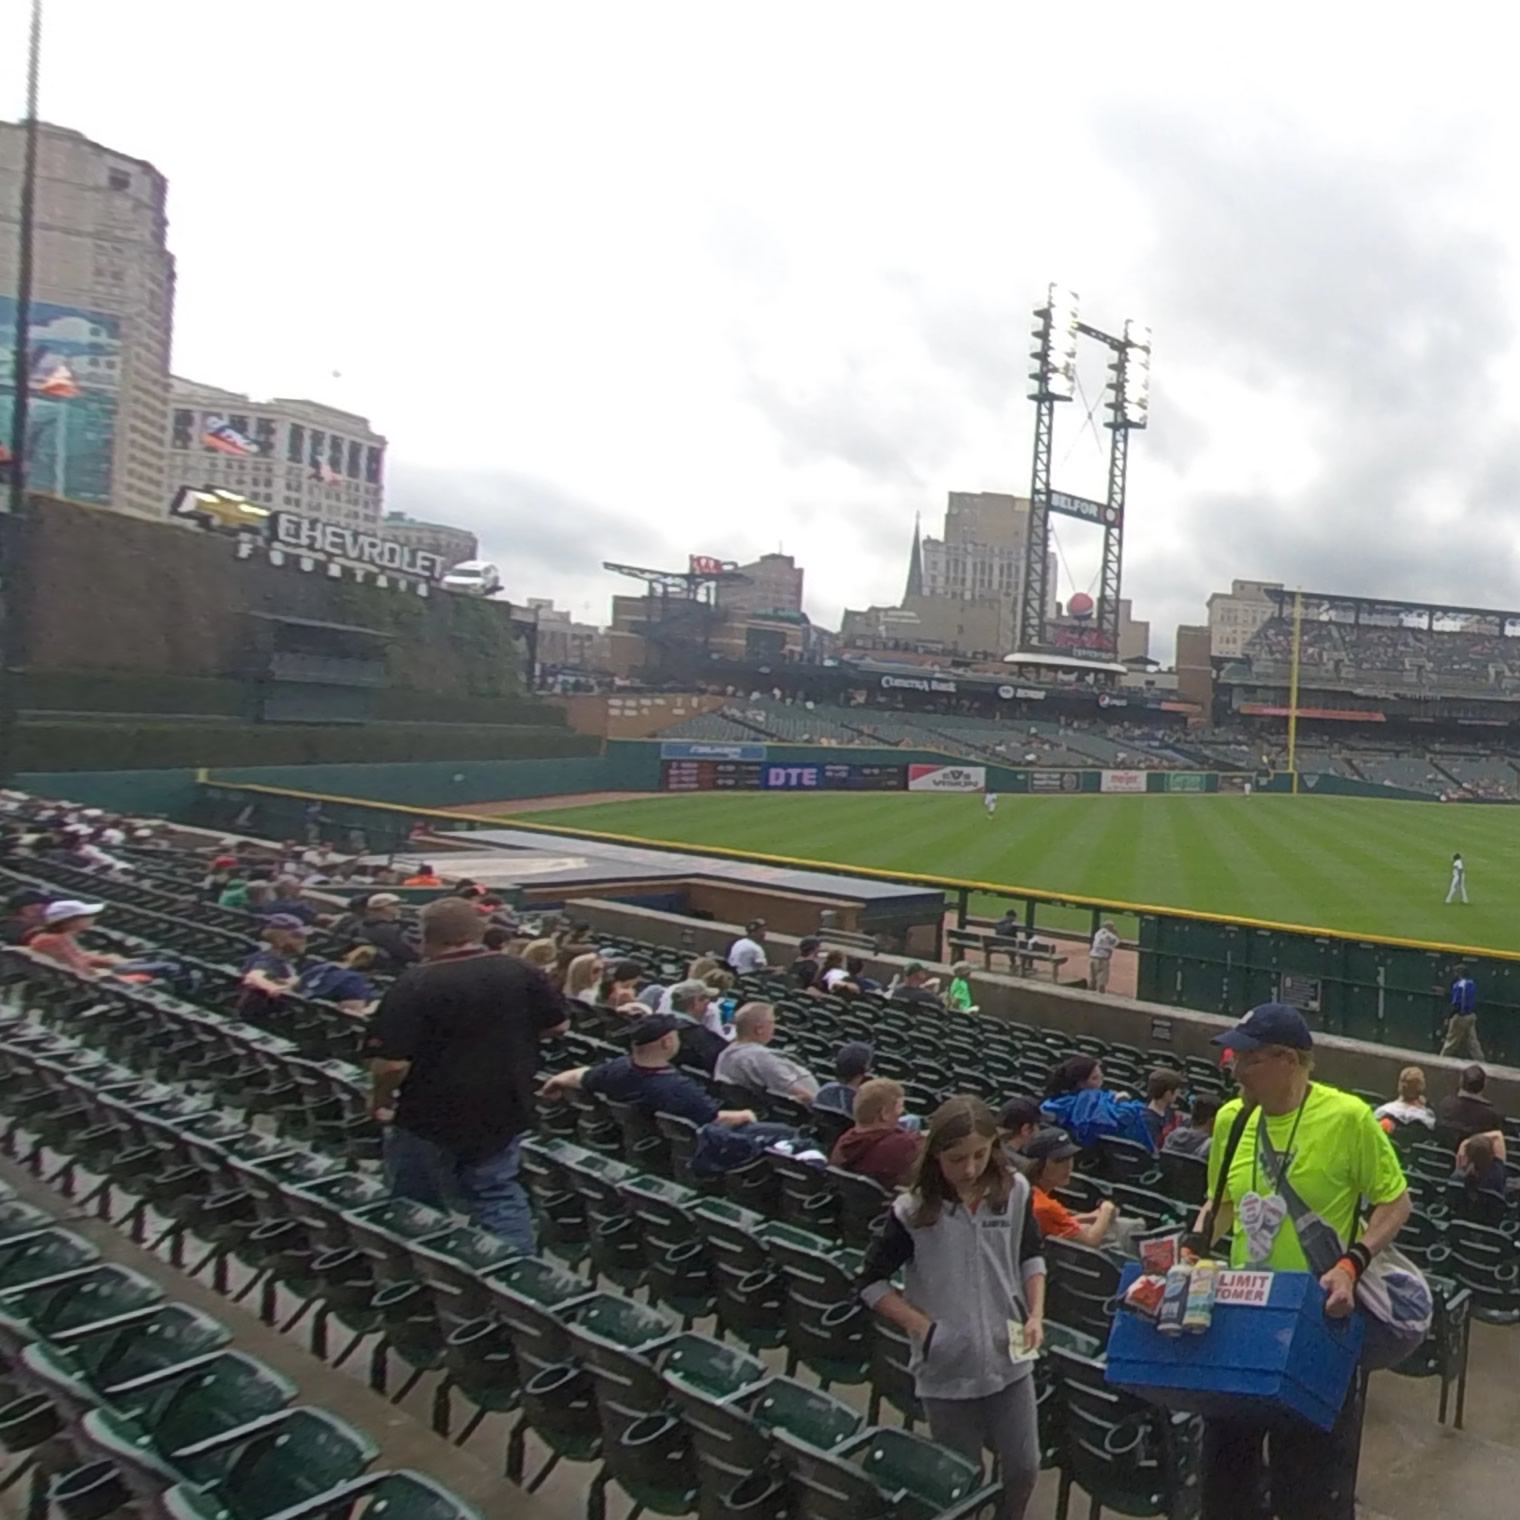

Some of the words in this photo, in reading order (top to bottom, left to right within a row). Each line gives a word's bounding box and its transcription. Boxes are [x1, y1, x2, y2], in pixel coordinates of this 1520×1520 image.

[1051, 492, 1099, 518] BELFOR
[277, 512, 447, 579] CHEVROLET
[768, 767, 818, 786] DTE
[1218, 1274, 1269, 1288] LIMIT
